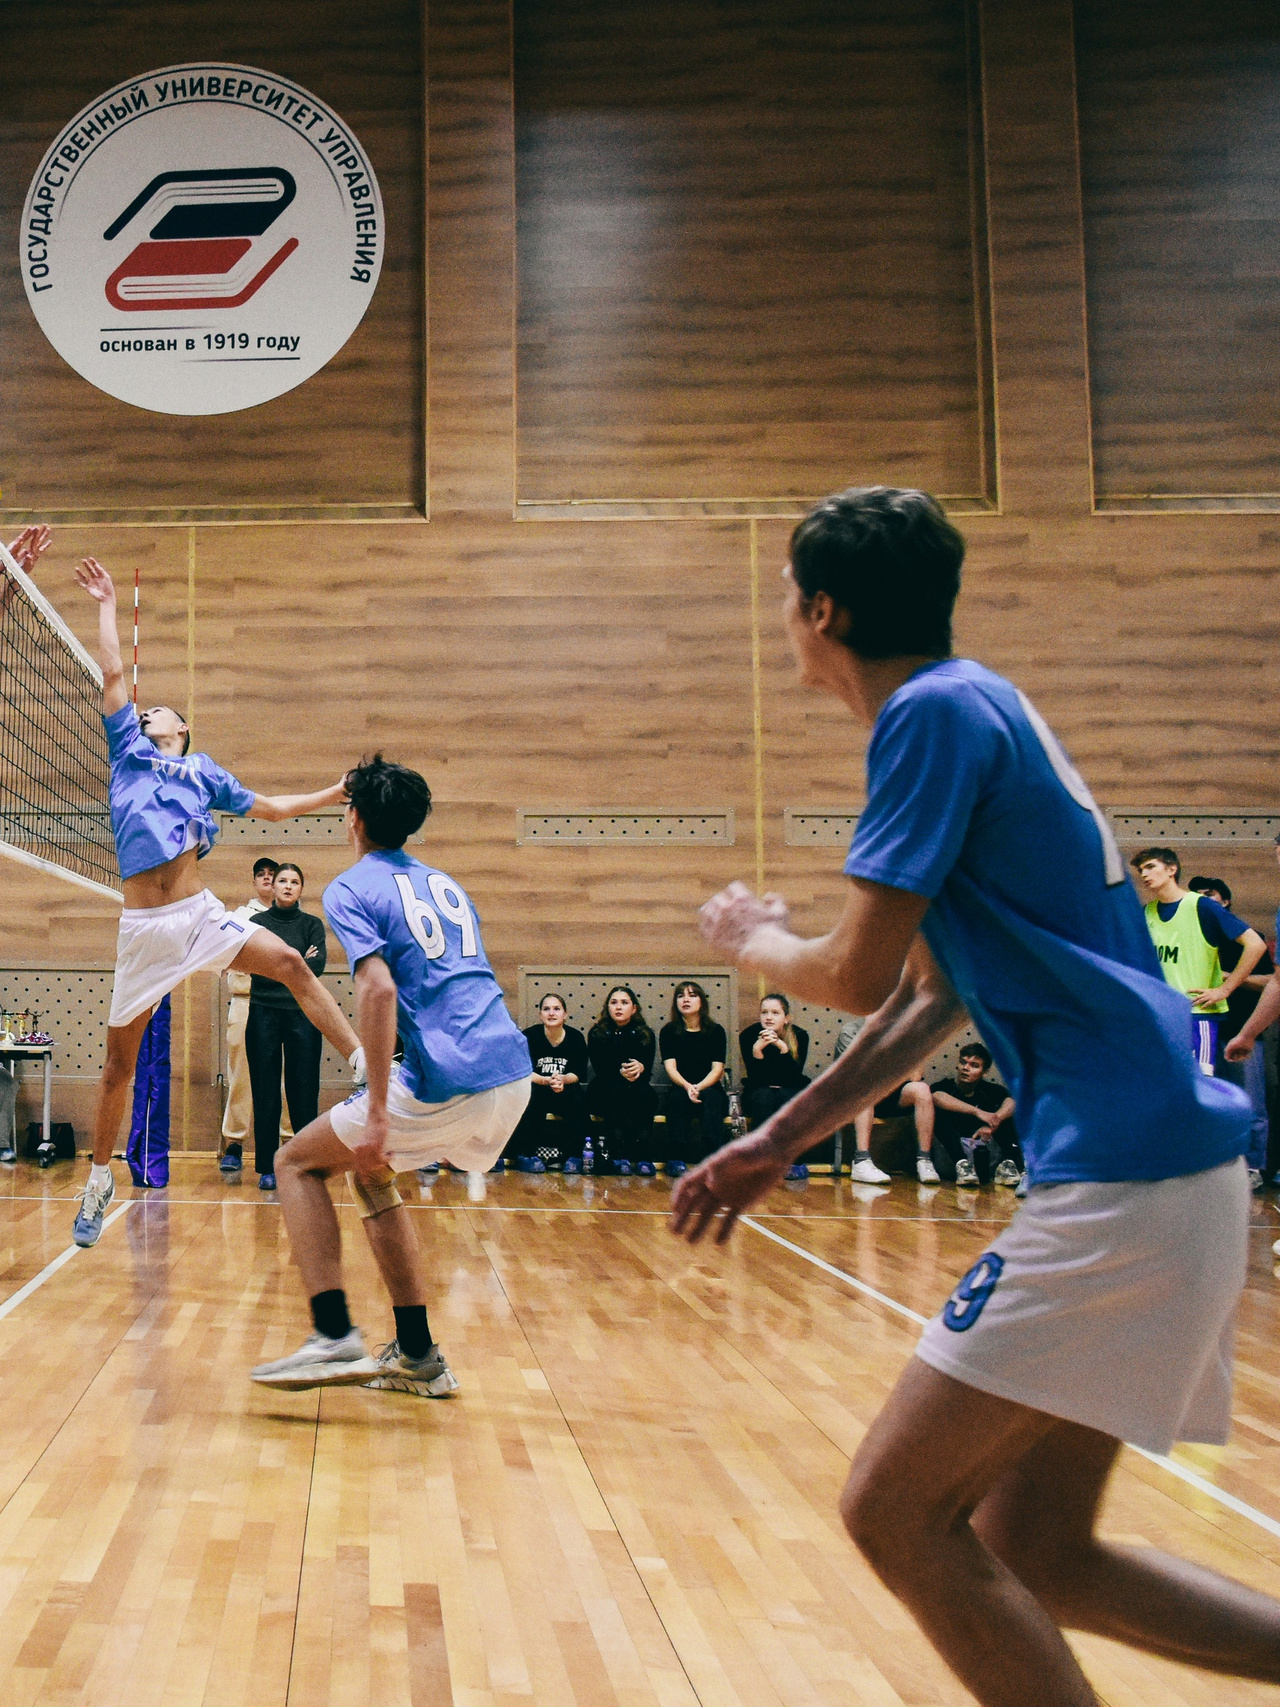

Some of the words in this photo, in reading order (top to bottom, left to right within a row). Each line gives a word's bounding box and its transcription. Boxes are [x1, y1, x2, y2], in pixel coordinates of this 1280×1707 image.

[27, 86, 150, 293] ГОСУДАРСТВЕННЫЙ
[155, 76, 324, 131] УНИВЕРСИТЕТ
[318, 127, 377, 284] УПРАВЛЕНИЯ
[99, 338, 178, 353] основан
[185, 337, 195, 350] в
[203, 333, 250, 350] 1919
[256, 336, 301, 352] году
[391, 873, 478, 960] 69
[942, 1251, 1006, 1333] 9
